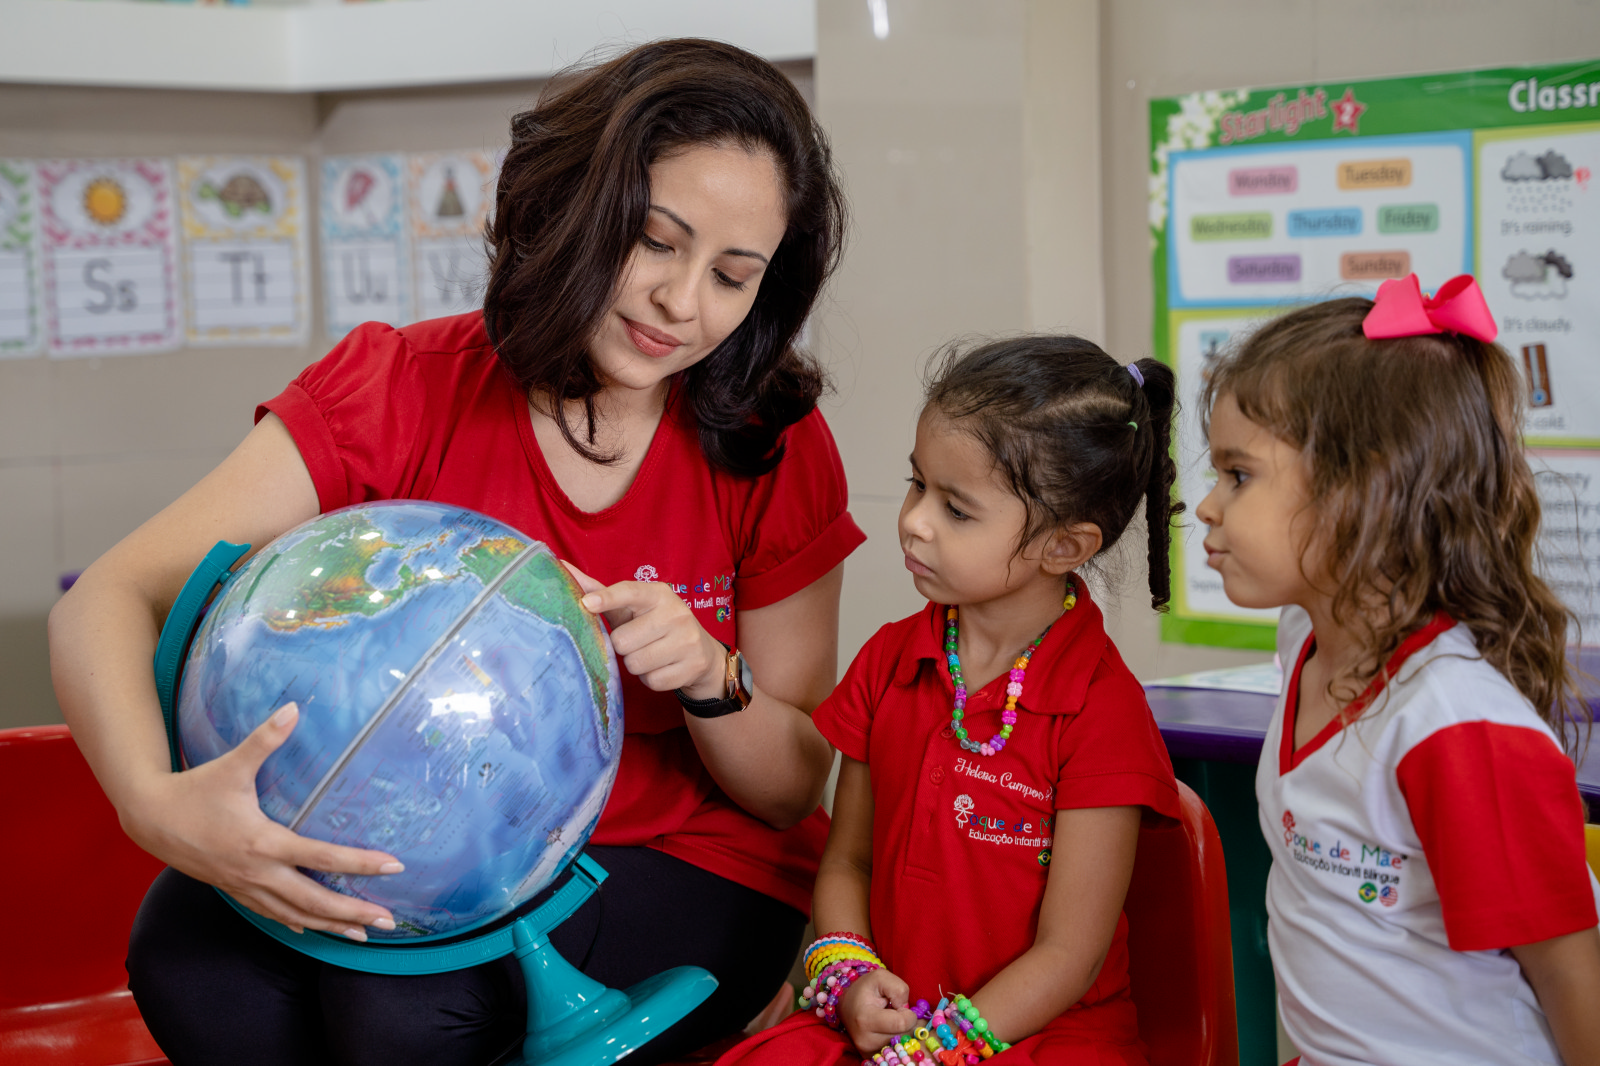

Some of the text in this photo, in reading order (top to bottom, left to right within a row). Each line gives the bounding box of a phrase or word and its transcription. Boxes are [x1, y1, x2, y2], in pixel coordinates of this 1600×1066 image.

[1507, 76, 1600, 113] Classr
[1218, 88, 1354, 145] Starlight 2
[1234, 171, 1293, 191] Monday
[1344, 165, 1406, 186] Tuesday
[1194, 216, 1272, 236] Wednesday
[1293, 212, 1359, 234] Thursday
[1384, 208, 1432, 229] Friday
[1233, 258, 1297, 280] Saturday
[1347, 256, 1404, 277] Sunday
[694, 577, 711, 593] de
[954, 757, 998, 784] Helena
[1013, 817, 1033, 833] de
[968, 828, 1013, 845] Educação
[1014, 835, 1041, 848] Infantil
[1329, 840, 1351, 861] de
[1360, 844, 1403, 870] Mãe
